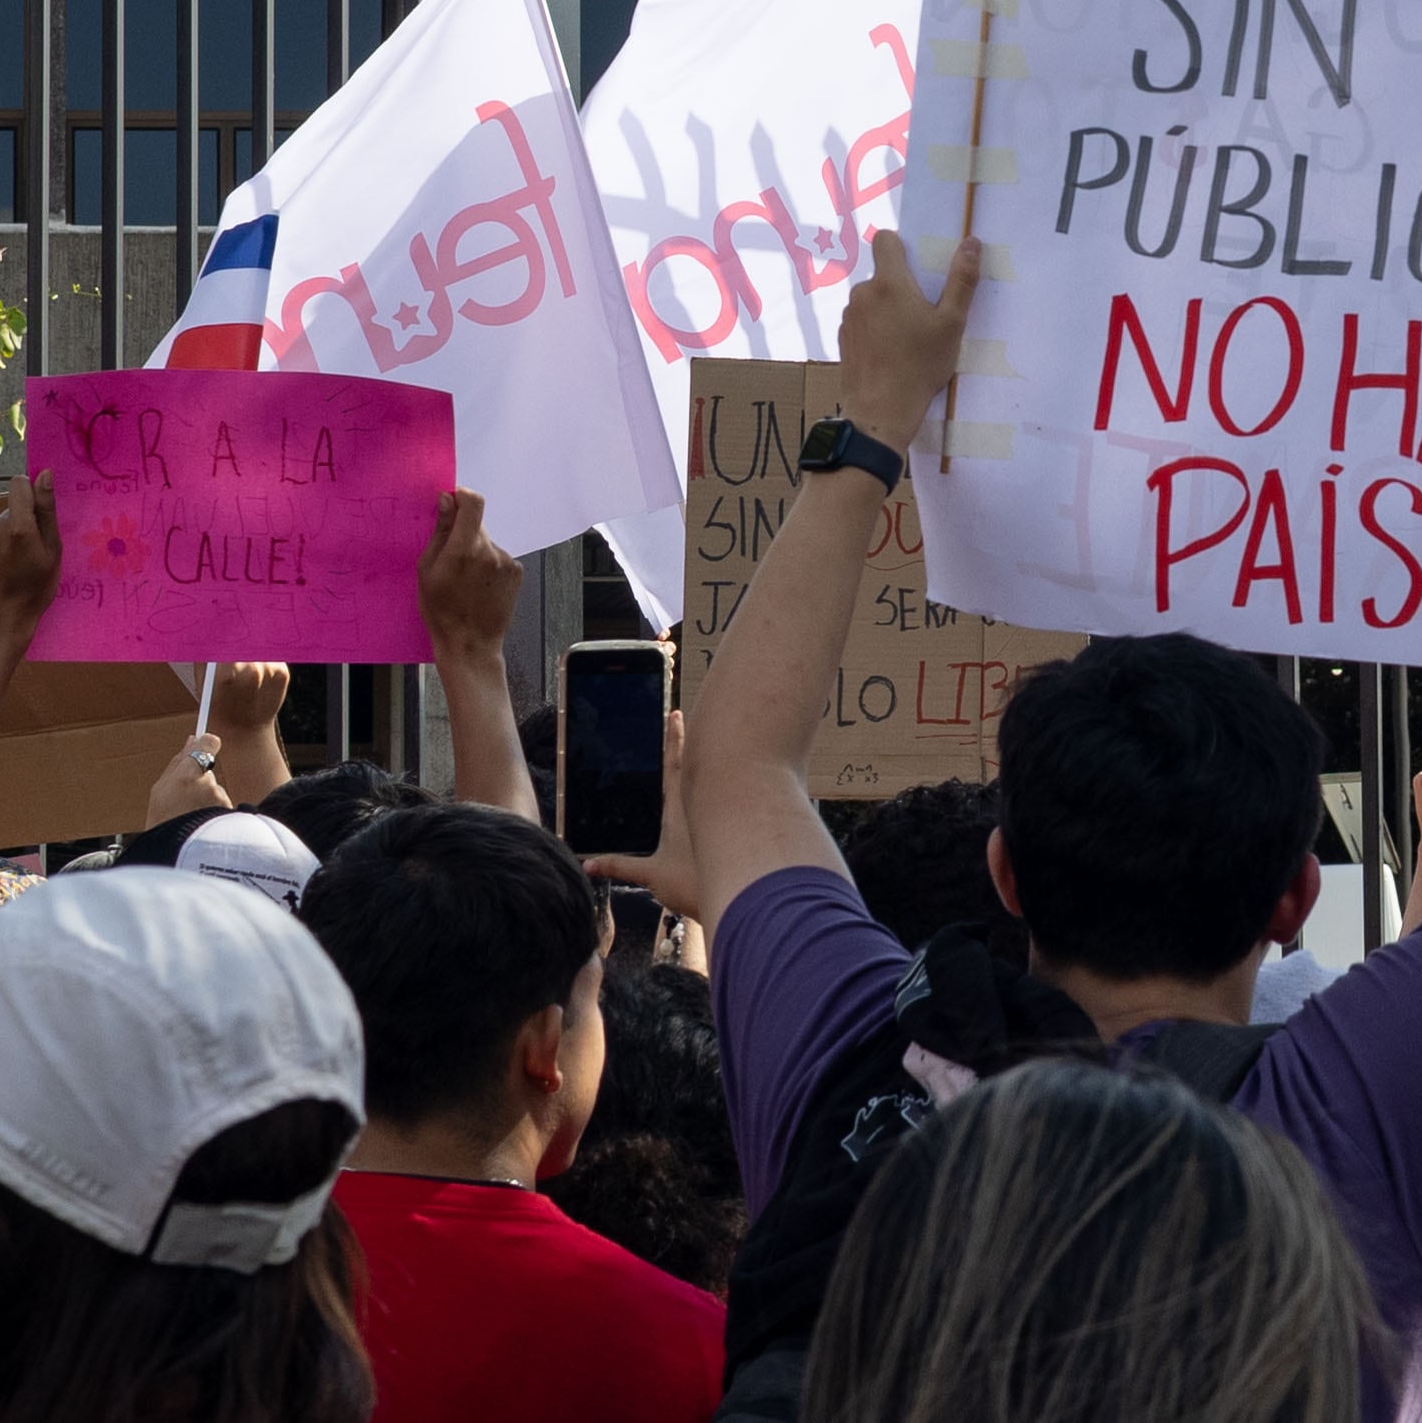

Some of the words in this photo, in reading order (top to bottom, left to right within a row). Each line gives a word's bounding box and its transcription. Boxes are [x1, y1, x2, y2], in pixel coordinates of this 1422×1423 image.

[1094, 292, 1306, 439] NO
[212, 419, 242, 479] A
[280, 417, 337, 485] LA
[165, 525, 308, 587] CALLE!
[697, 496, 786, 563] SIN
[916, 660, 1041, 726] LIB
